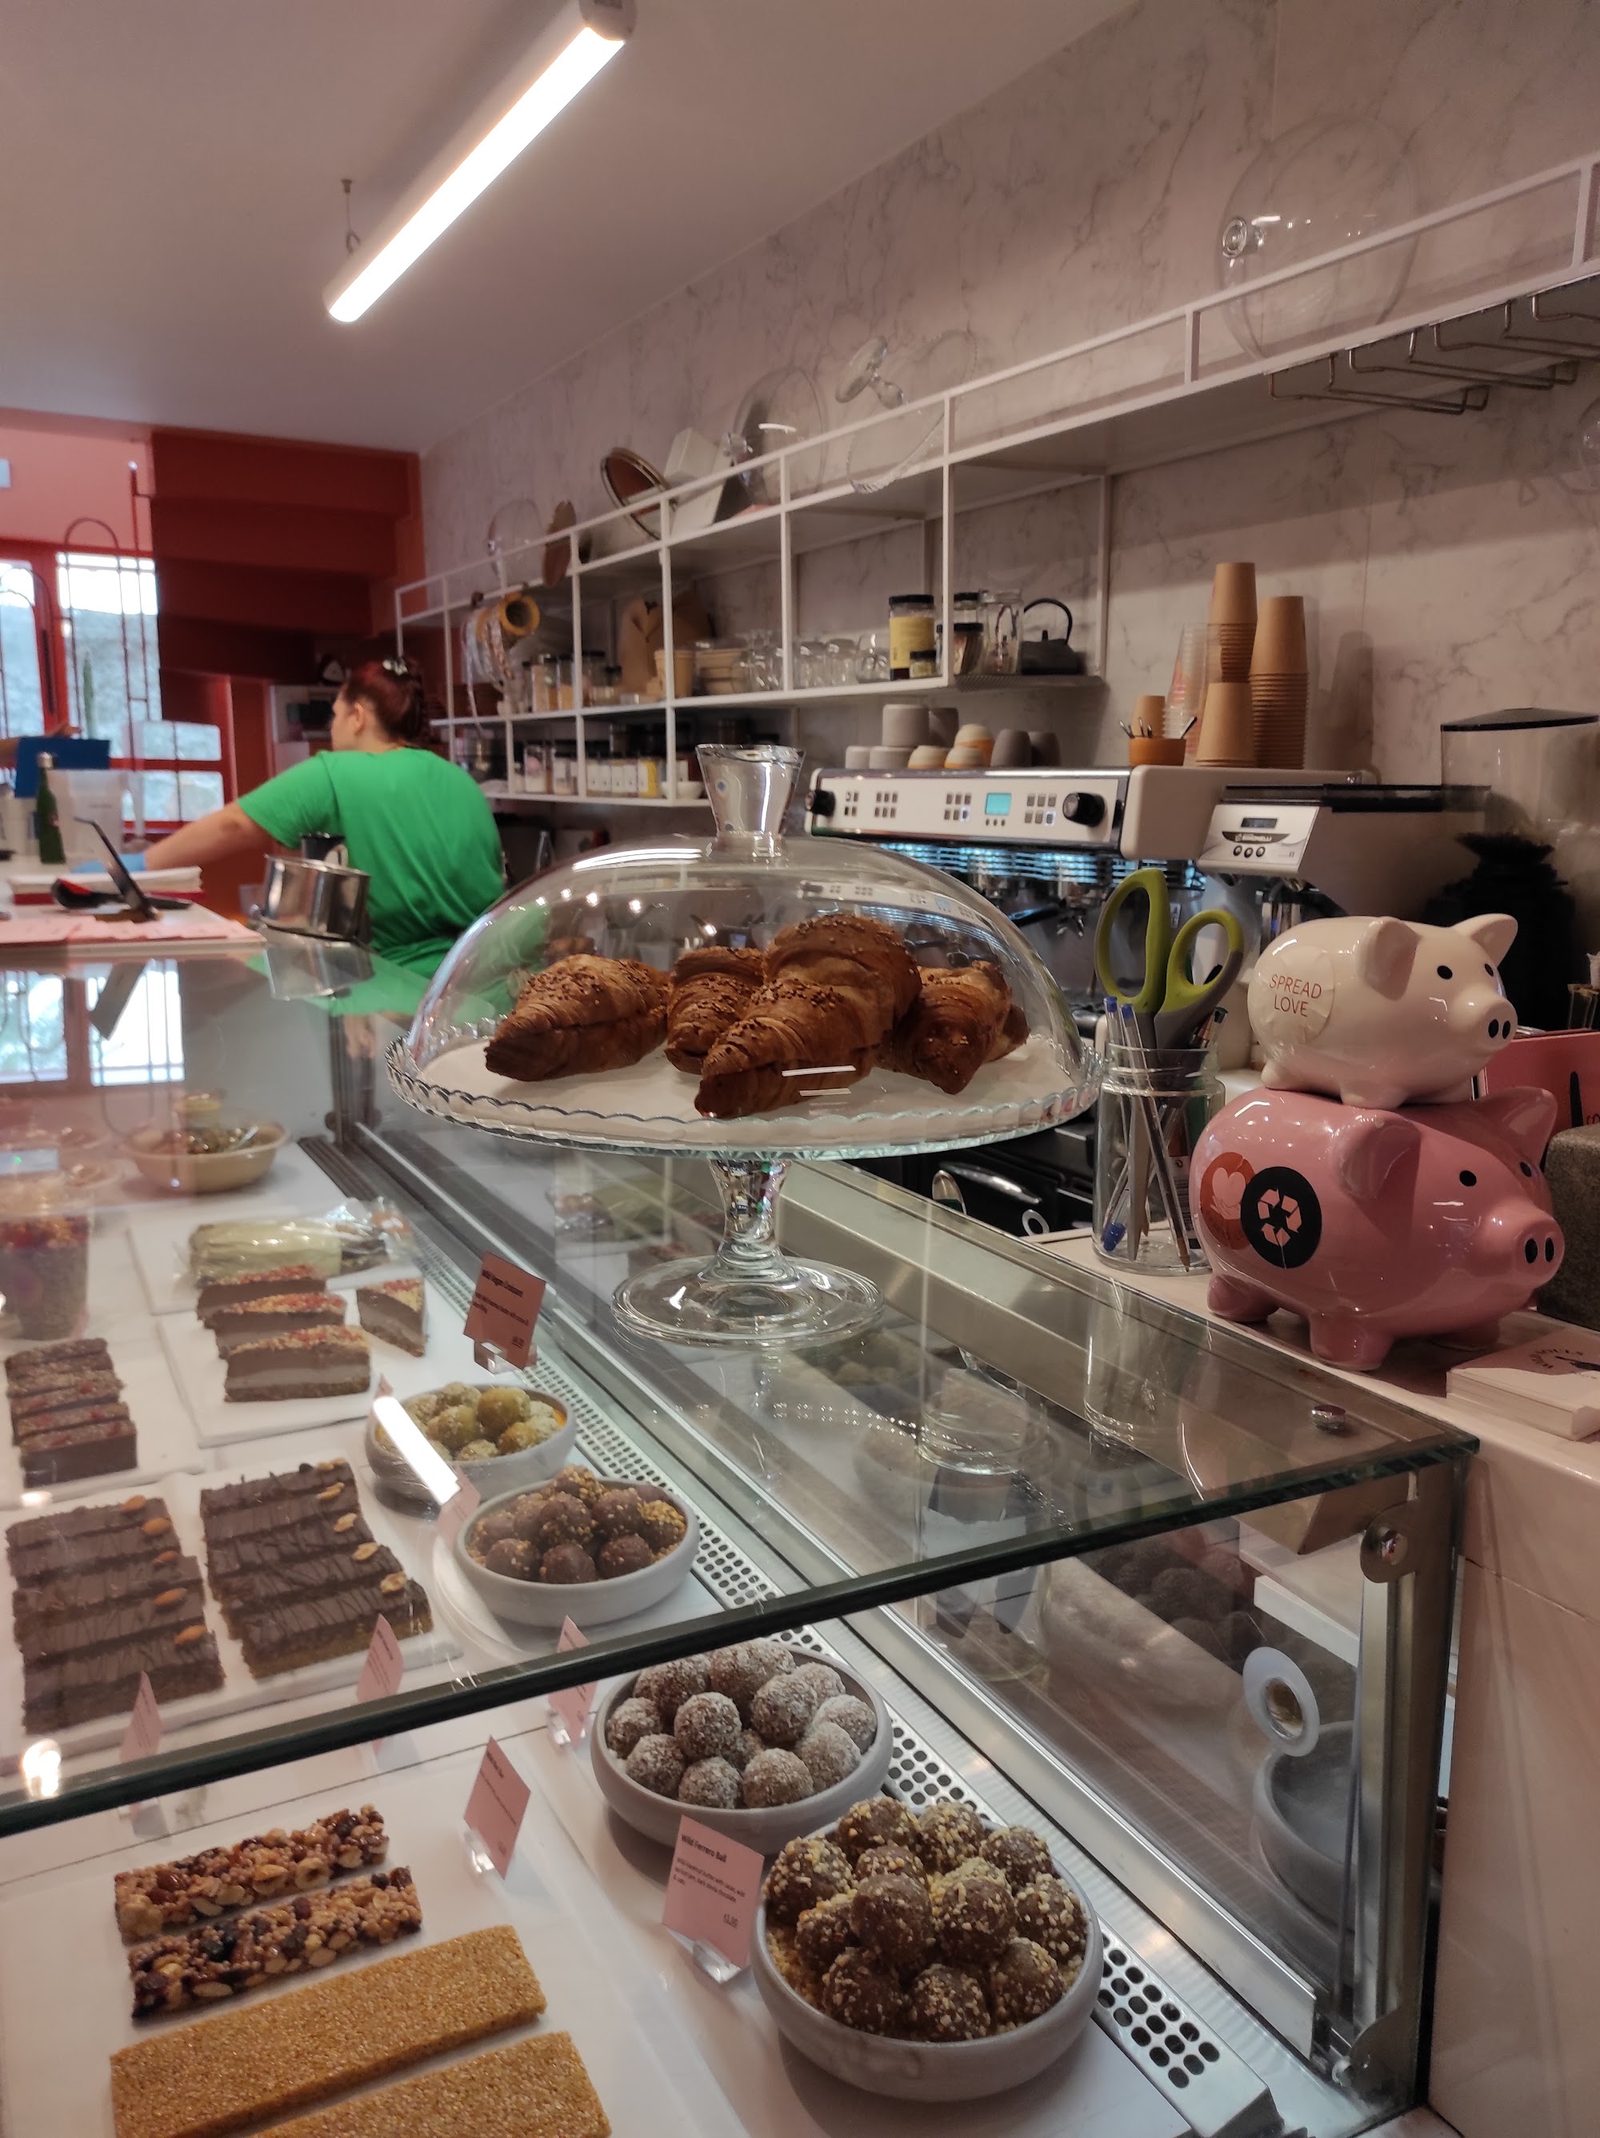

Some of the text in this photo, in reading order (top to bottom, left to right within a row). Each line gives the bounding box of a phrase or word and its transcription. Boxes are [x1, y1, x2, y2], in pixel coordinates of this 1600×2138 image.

[1269, 973, 1322, 1000] SPREAD
[1274, 994, 1309, 1018] LOVE
[694, 1840, 715, 1857] Ferrero
